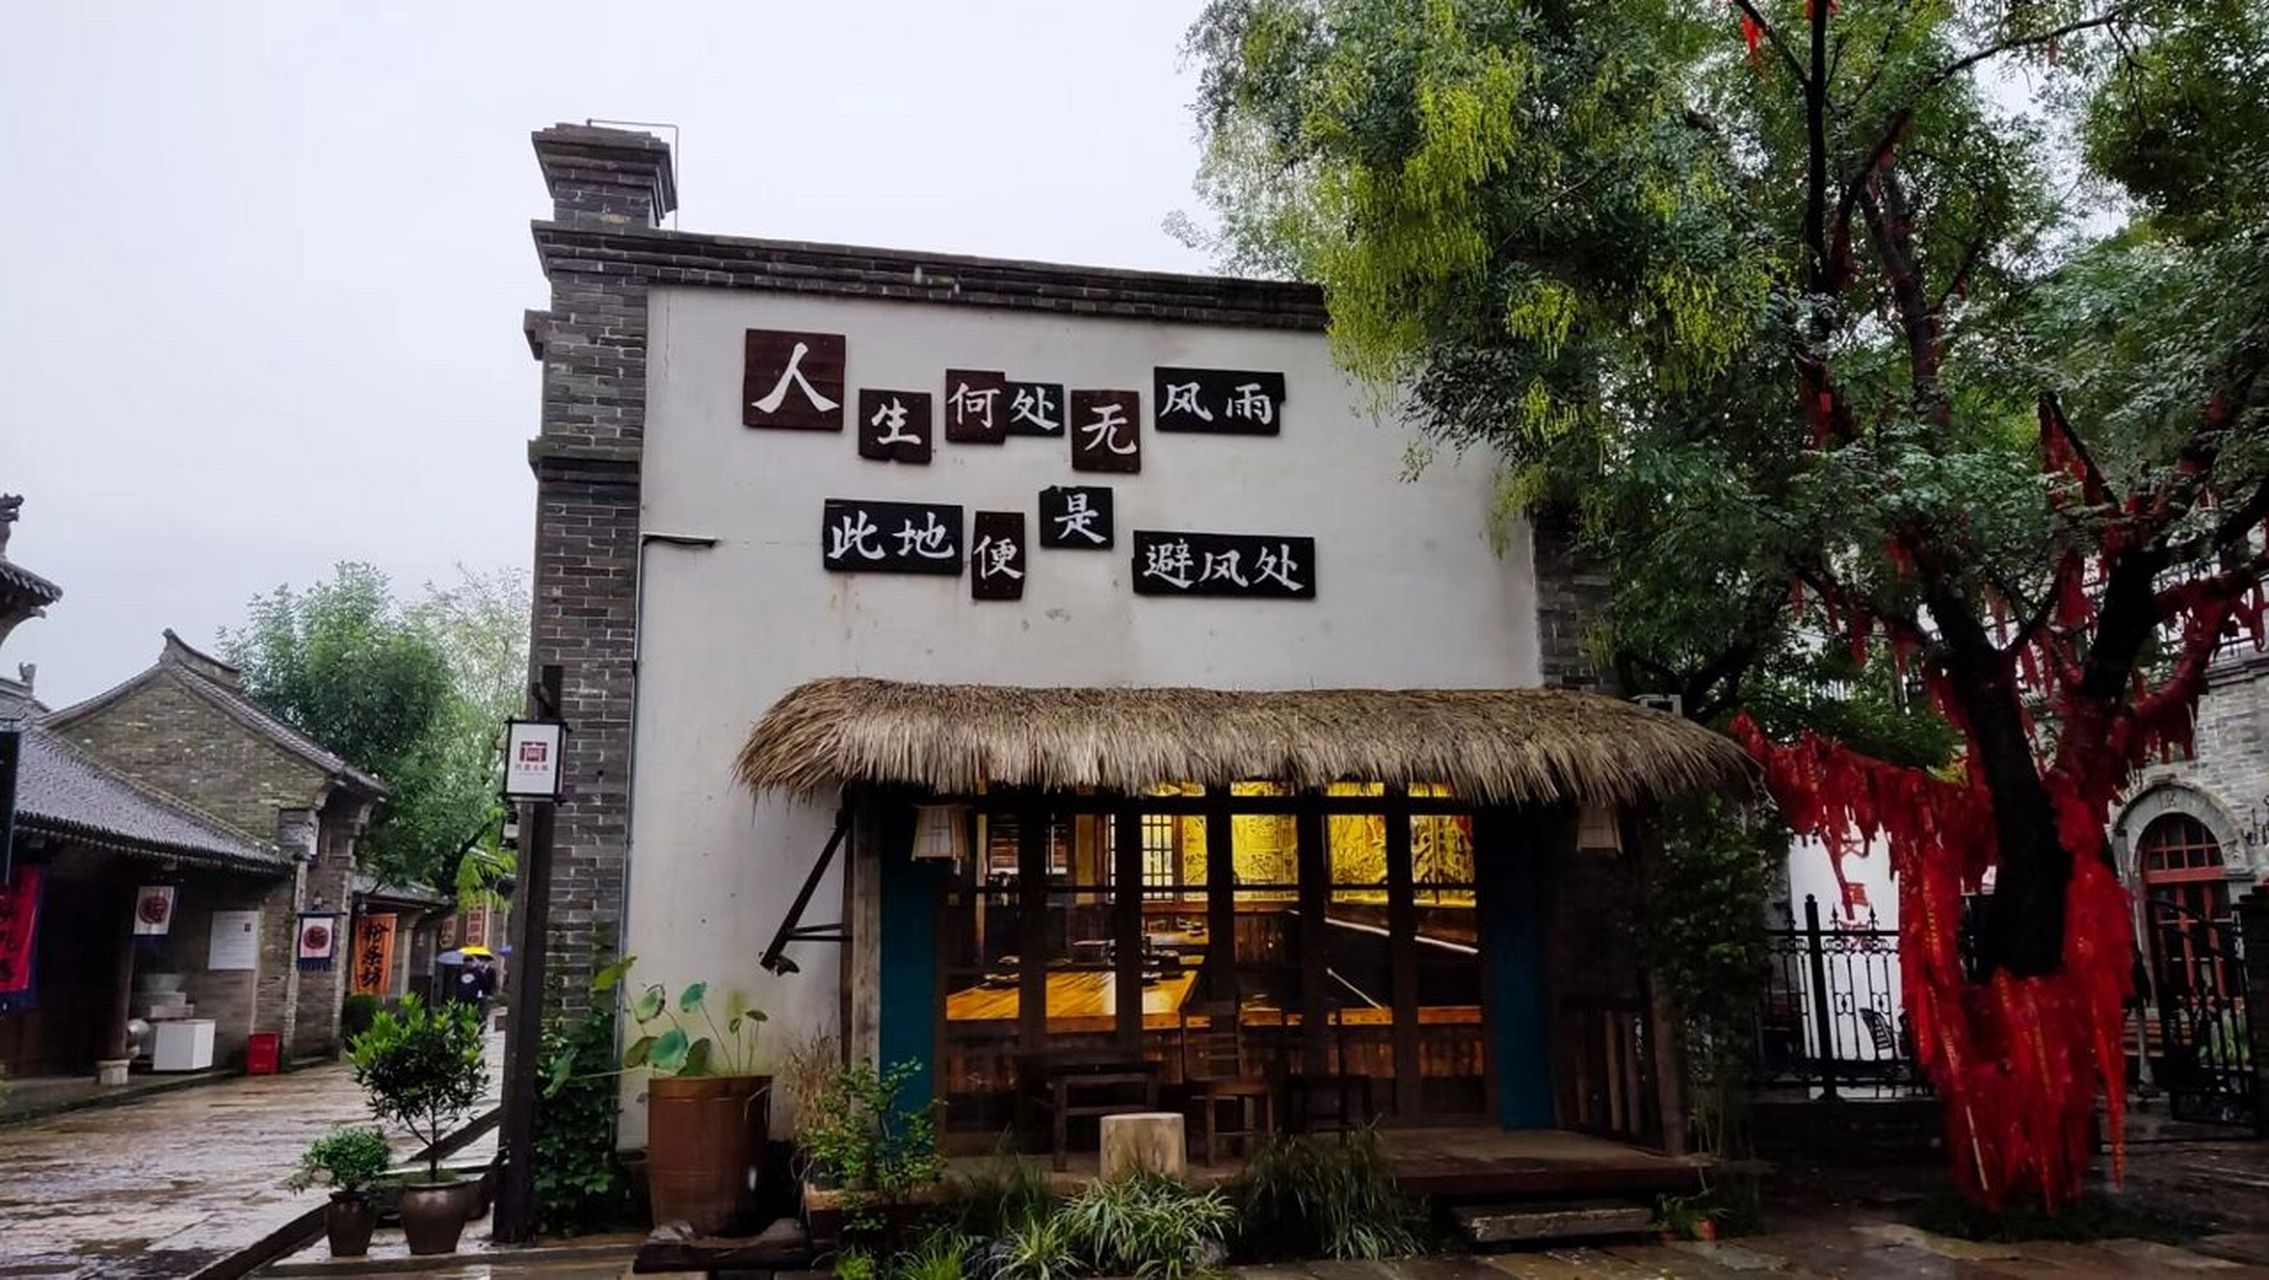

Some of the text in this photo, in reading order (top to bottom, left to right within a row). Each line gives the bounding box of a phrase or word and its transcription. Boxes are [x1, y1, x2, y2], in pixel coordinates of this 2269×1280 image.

[752, 343, 1274, 456] 人生何处无风雨
[827, 492, 1305, 591] 此地便是避风处
